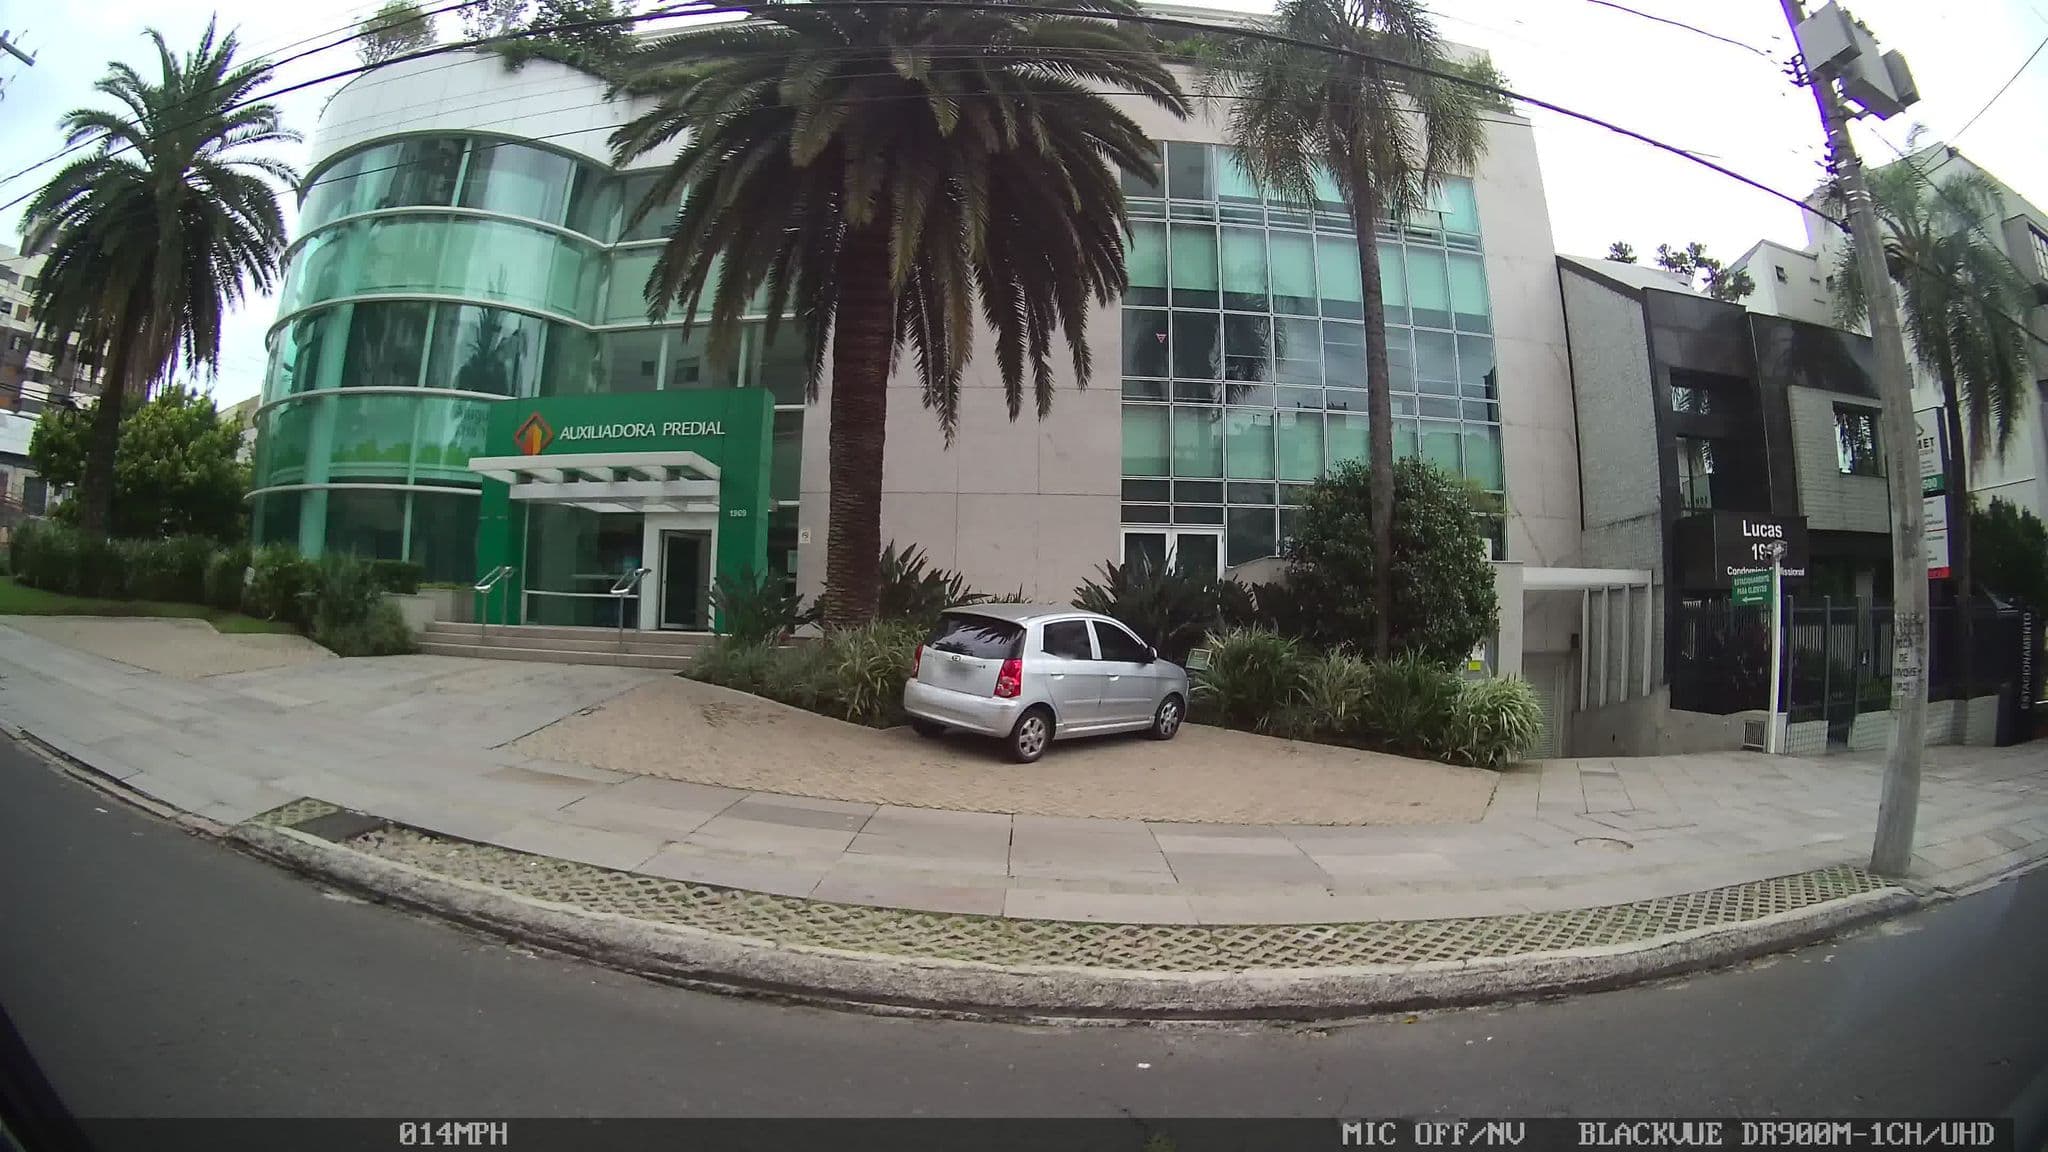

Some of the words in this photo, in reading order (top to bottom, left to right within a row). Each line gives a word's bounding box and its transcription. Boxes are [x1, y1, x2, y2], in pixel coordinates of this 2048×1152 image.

[560, 423, 656, 440] AUXILIADORA
[662, 421, 725, 437] PREDIAL
[1743, 519, 1783, 538] Lucas
[2021, 612, 2032, 710] ESTACIONAMENTO
